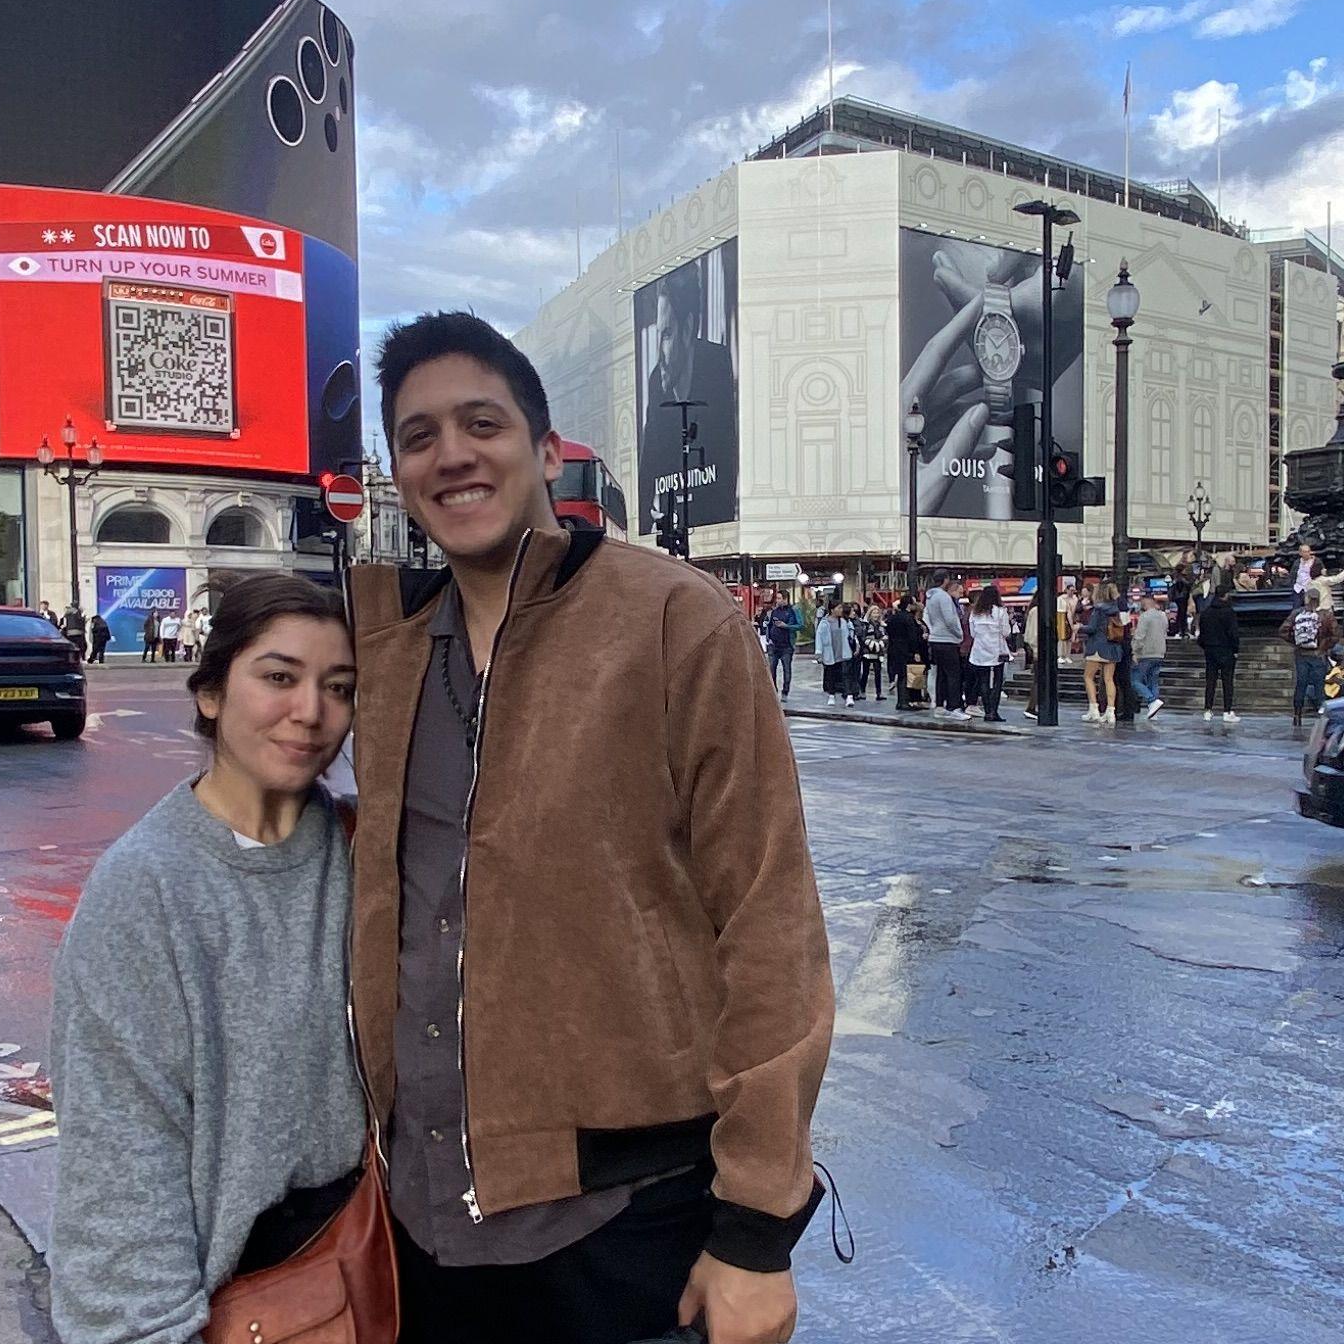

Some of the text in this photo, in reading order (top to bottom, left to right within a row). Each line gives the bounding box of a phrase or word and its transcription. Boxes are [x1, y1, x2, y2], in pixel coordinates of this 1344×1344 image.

[92, 224, 210, 250] SCAN NOW TO
[47, 258, 268, 287] TURN UP YOUR SUMMER
[149, 351, 197, 372] Coke
[154, 370, 194, 381] STUDIO
[941, 457, 986, 479] LOUIS
[119, 597, 182, 609] AVAILABLE
[141, 588, 176, 599] space
